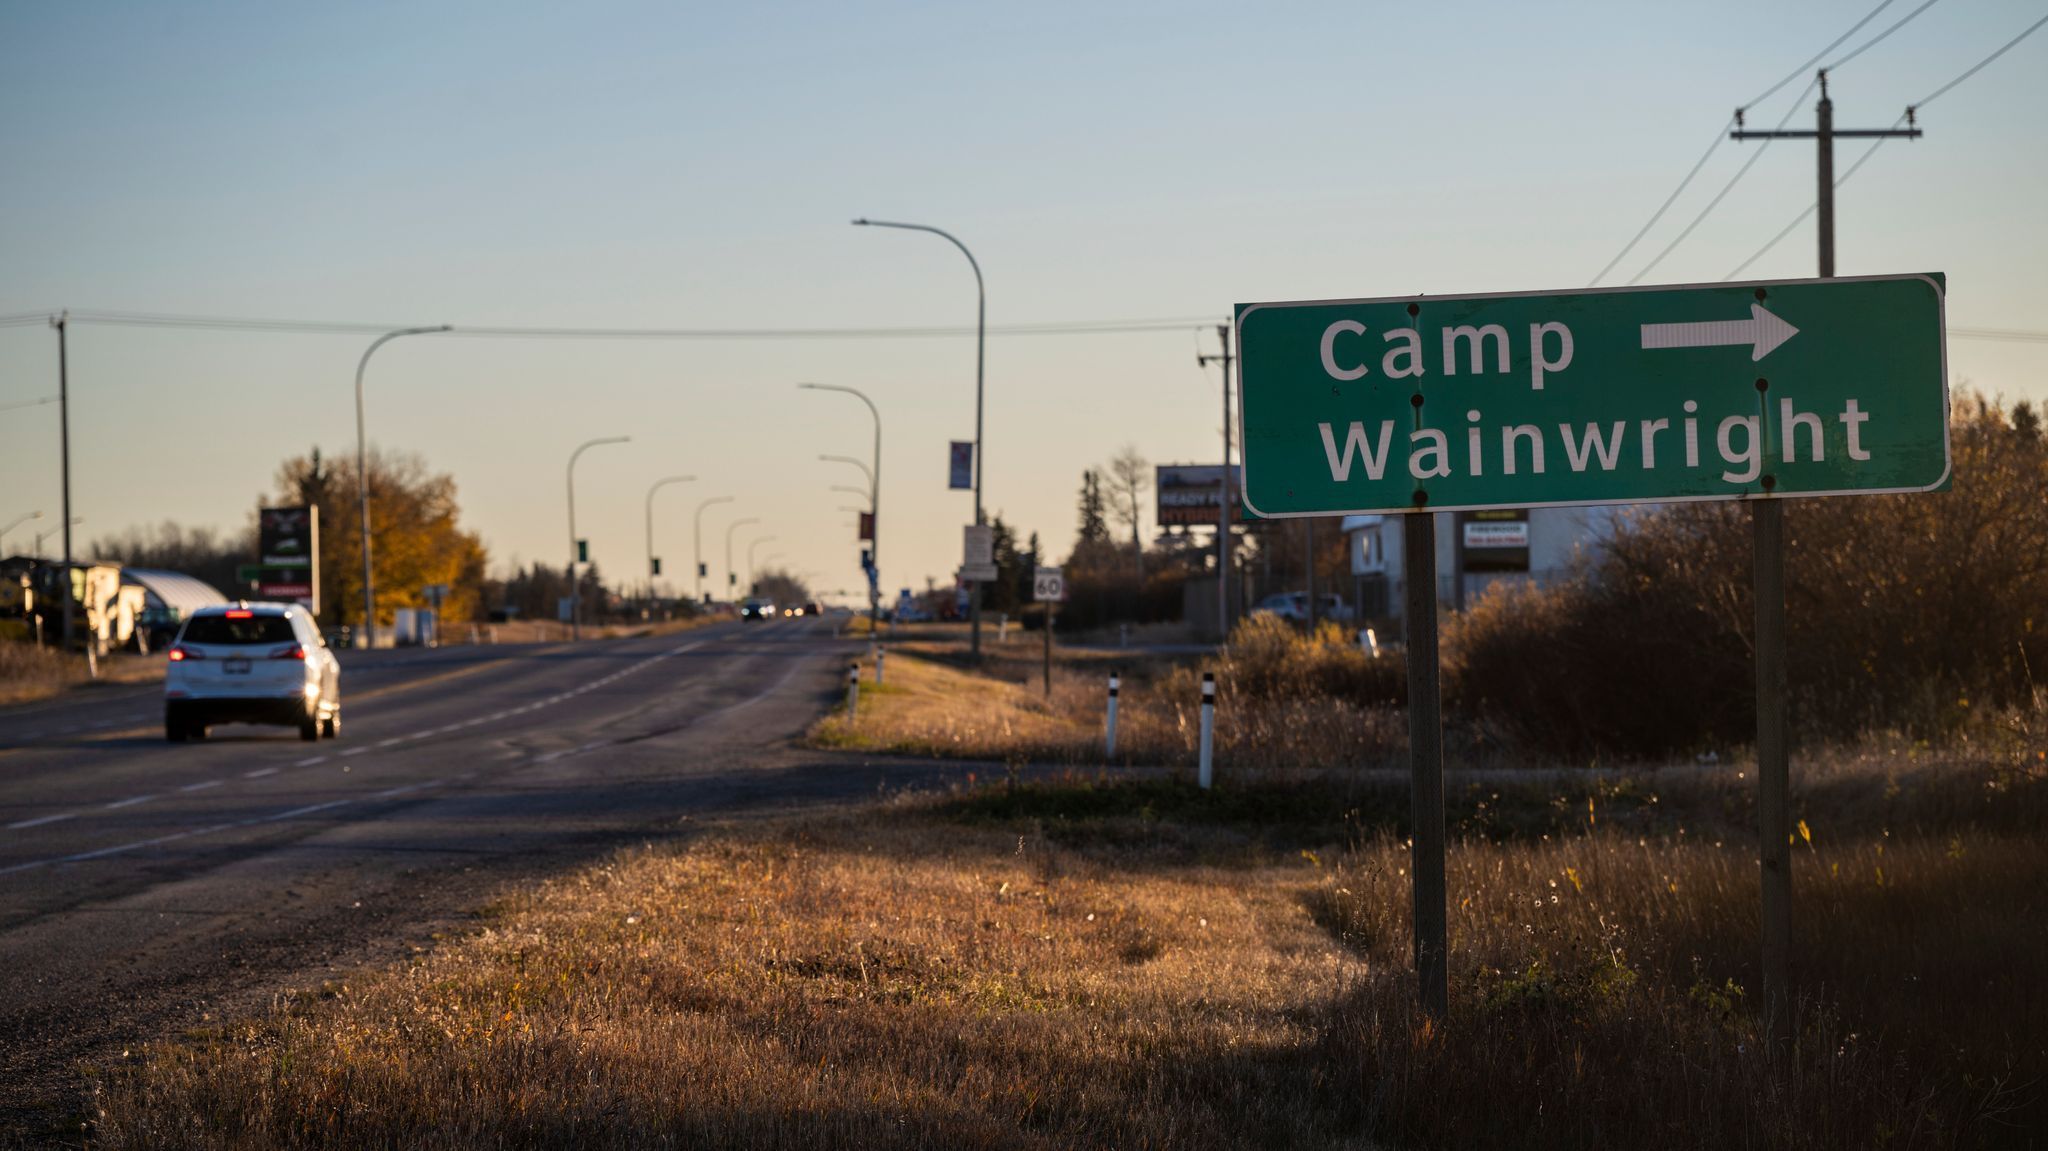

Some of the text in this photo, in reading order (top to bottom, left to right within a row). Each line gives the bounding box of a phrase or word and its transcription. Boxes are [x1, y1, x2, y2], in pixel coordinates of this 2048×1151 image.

[1319, 319, 1575, 391] Camp
[1317, 398, 1872, 485] Wainwright
[1037, 578, 1061, 596] 60
